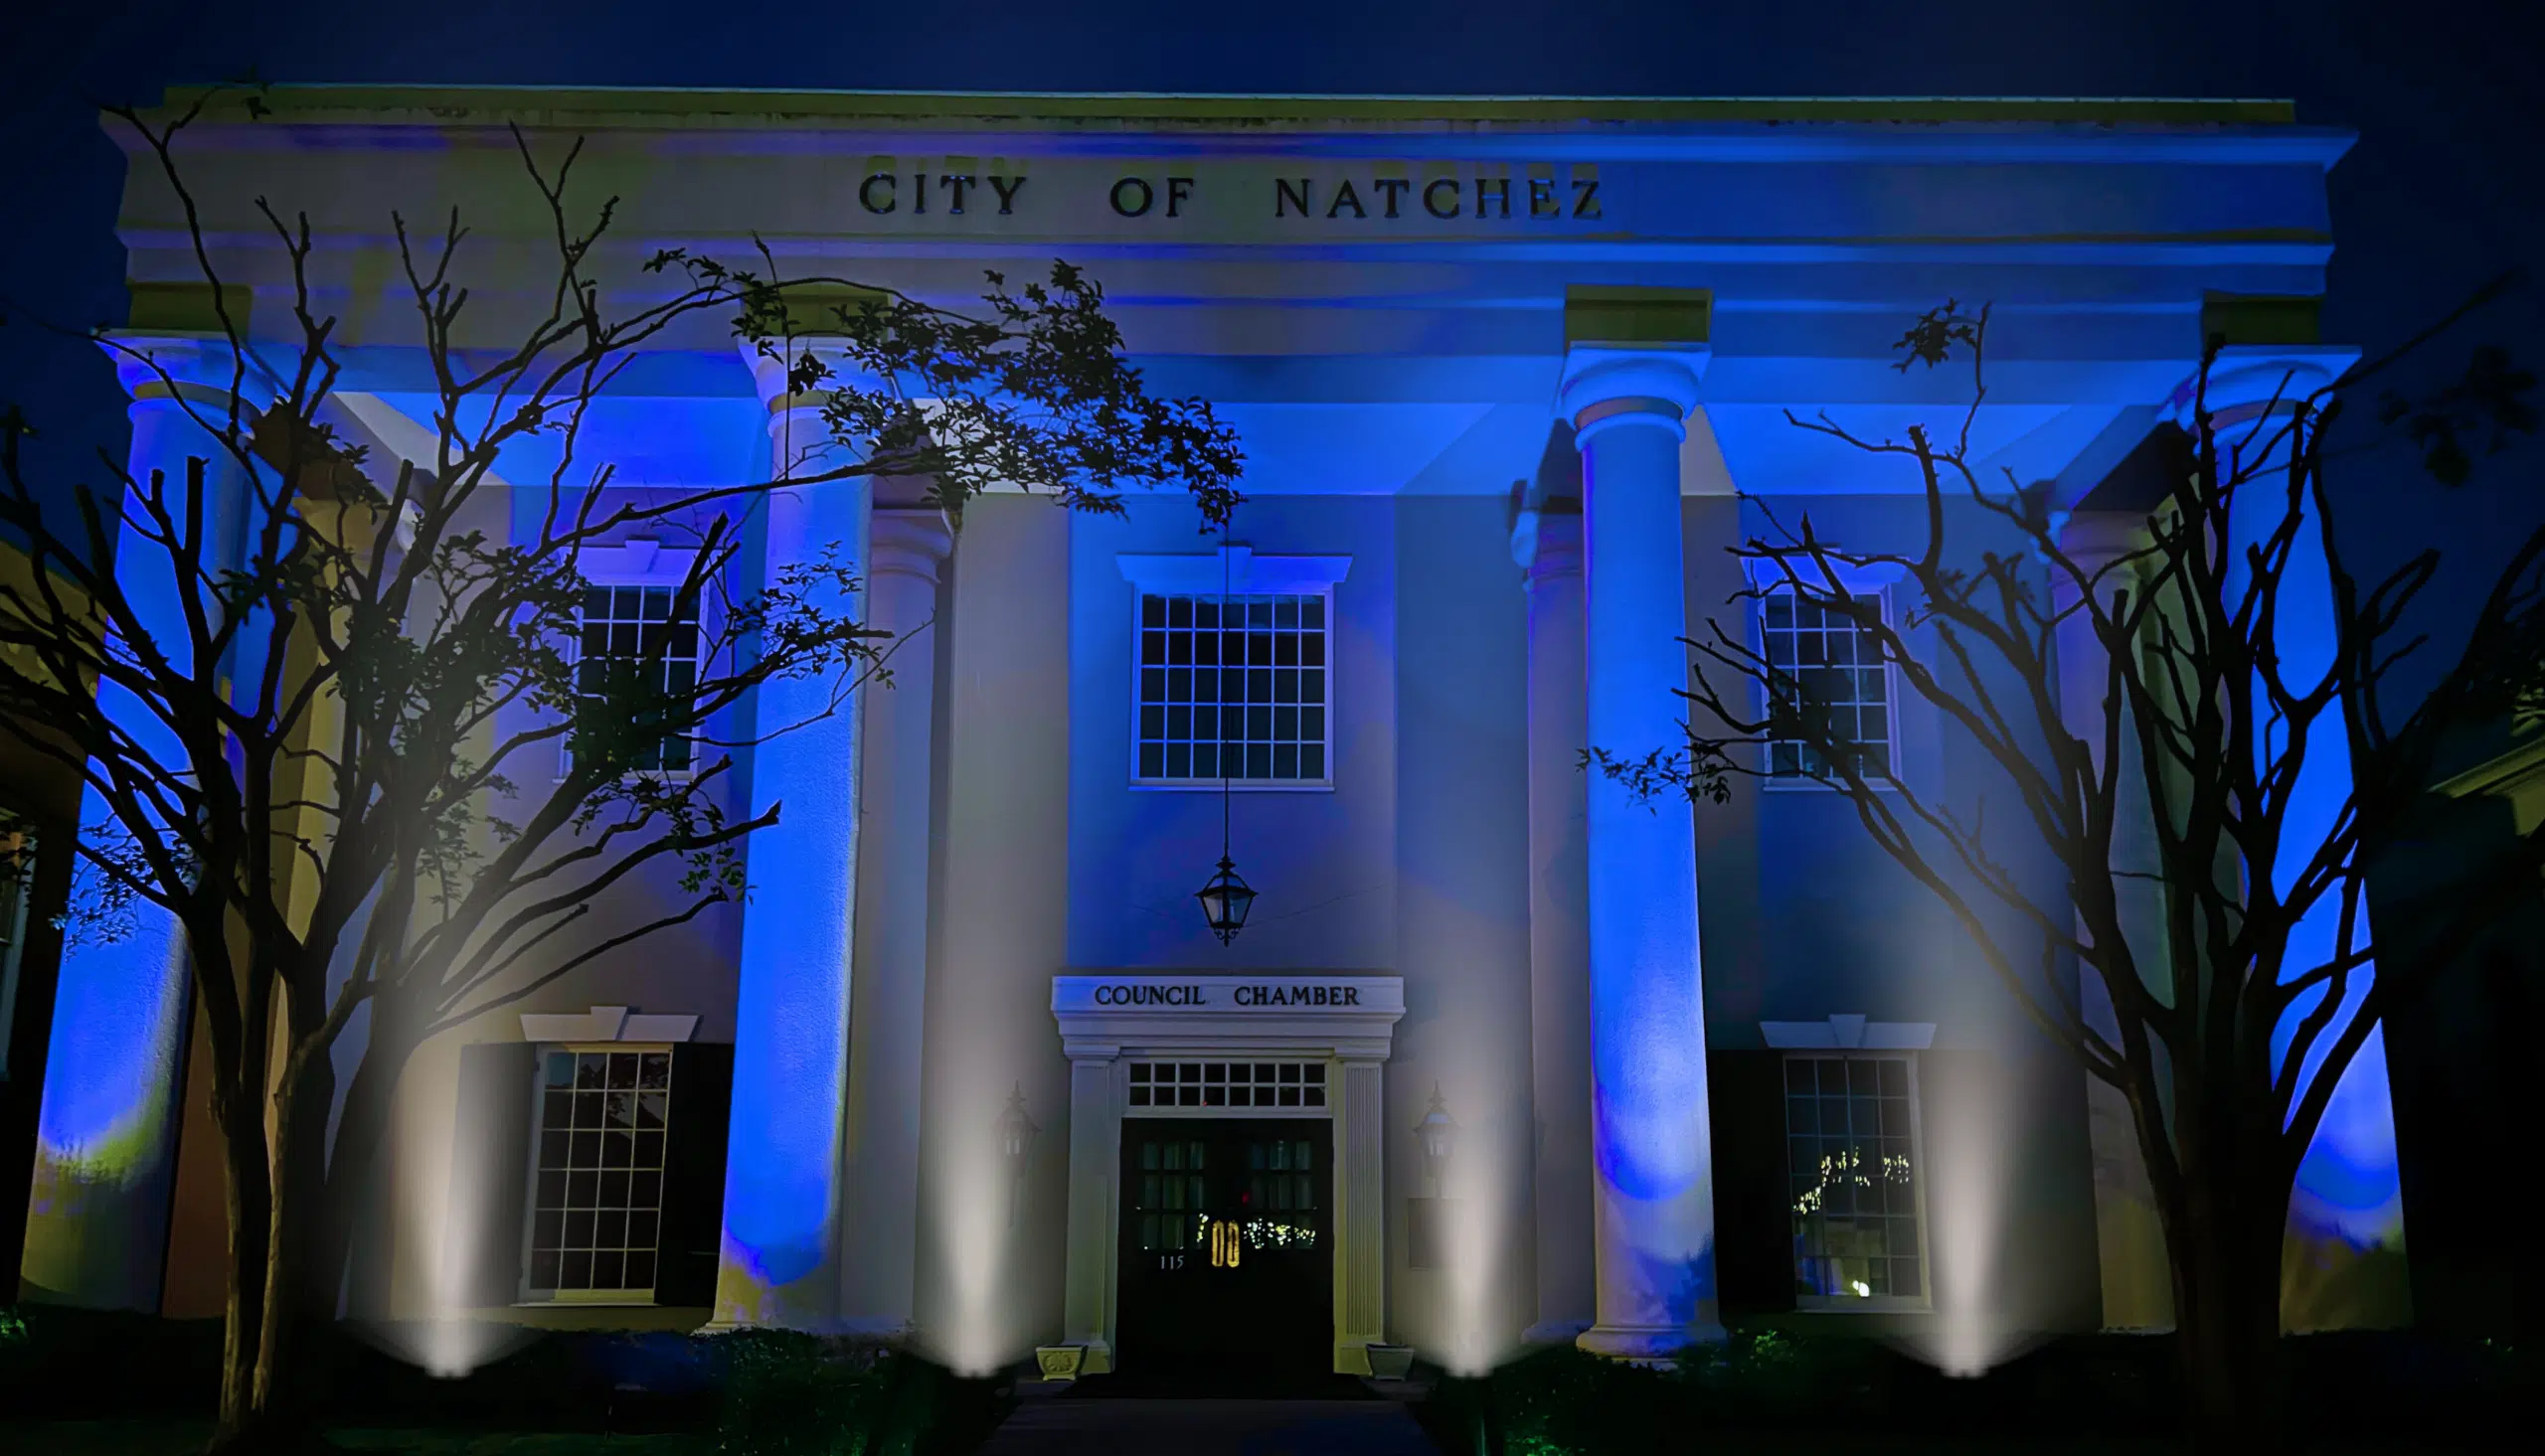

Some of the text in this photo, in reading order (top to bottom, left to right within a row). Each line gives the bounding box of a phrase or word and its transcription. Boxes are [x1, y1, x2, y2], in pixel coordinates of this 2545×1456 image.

[859, 174, 1603, 220] CITY OF NATCHEZ
[1095, 985, 1360, 1006] COUNCIL CHAMBER
[1160, 1255, 1185, 1270] 115
